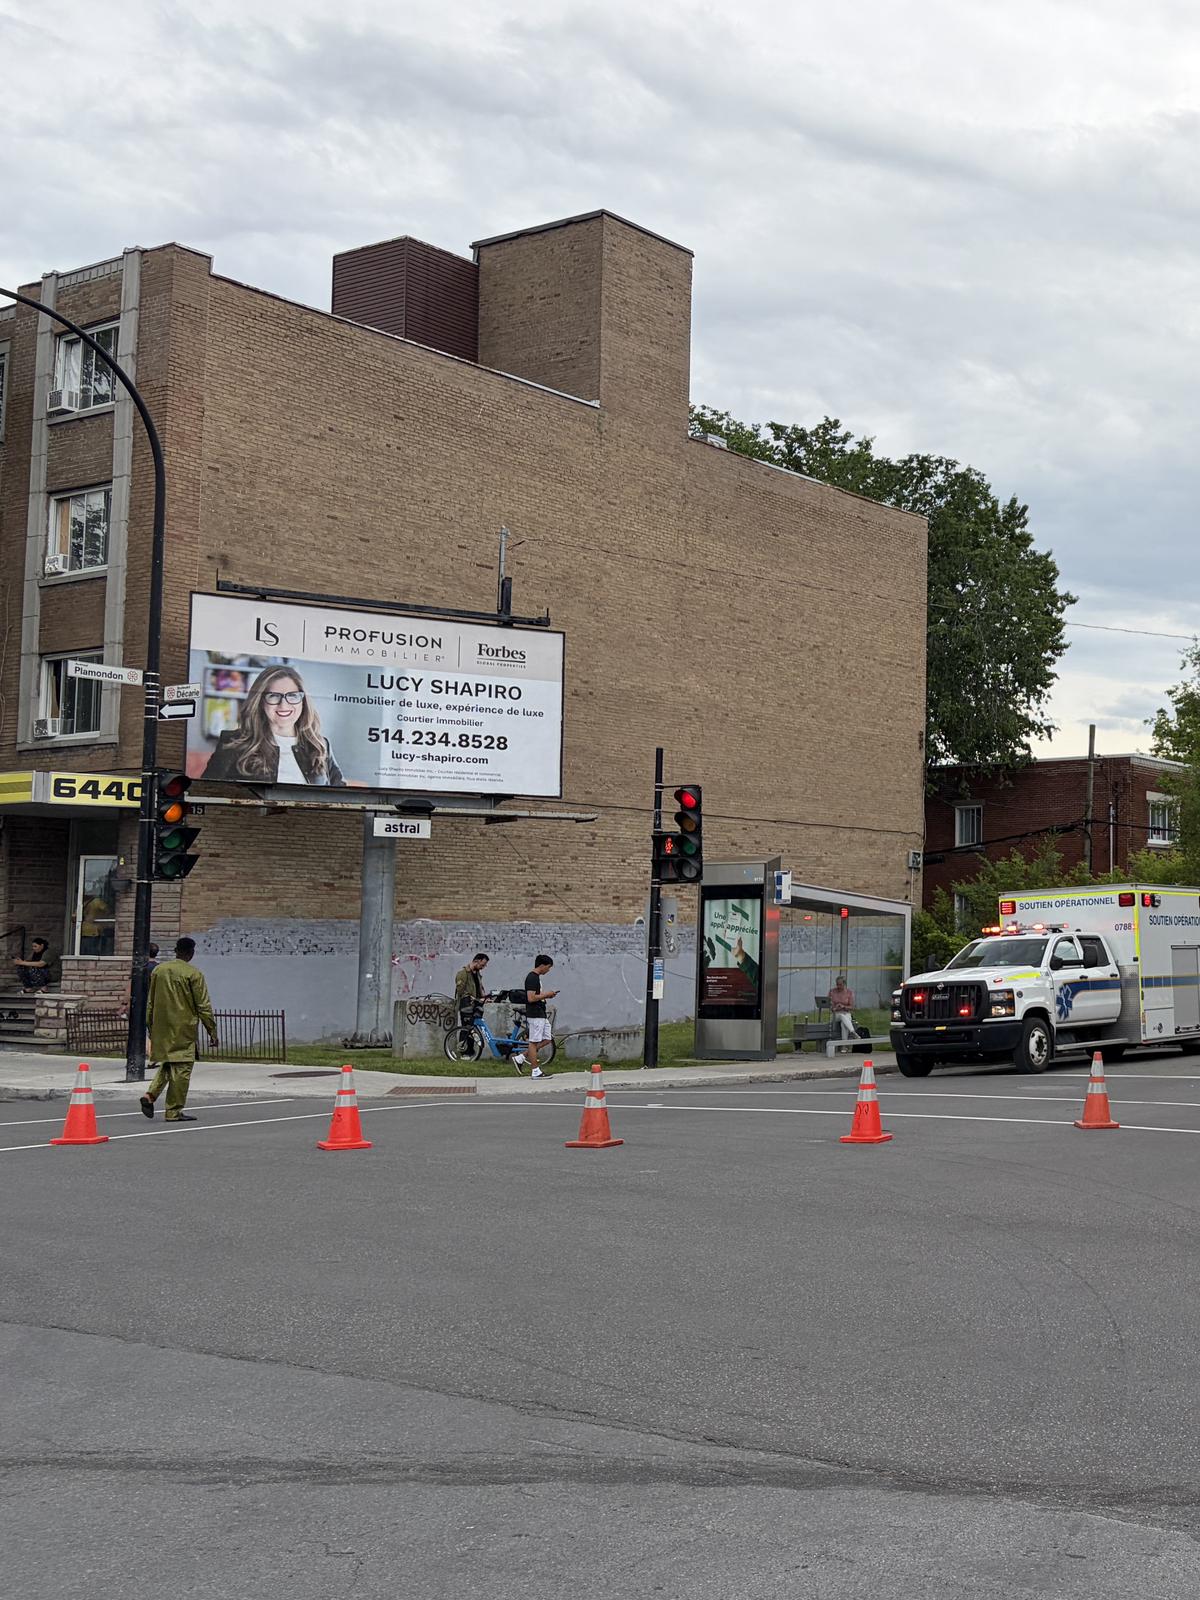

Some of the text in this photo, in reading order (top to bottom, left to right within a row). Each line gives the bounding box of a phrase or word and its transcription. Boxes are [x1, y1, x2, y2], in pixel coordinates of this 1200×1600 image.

[324, 625, 442, 649] PROFUSION
[324, 644, 442, 662] IMMOBILIER
[476, 642, 526, 660] Forbes
[74, 665, 124, 681] Plamondon
[366, 673, 522, 701] LUCY SHAPIRO
[333, 693, 544, 718] Immobilier de luxe, expérience de luxe
[396, 714, 484, 728] Courtier immobilier
[367, 727, 509, 751] 514.234.8528
[391, 750, 489, 765] lucy-shapiro.com
[53, 777, 143, 802] 6440
[384, 822, 420, 834] astral
[1019, 896, 1115, 911] SOUTIEN OPÉRATIONNEL
[714, 911, 727, 921] Une
[1149, 914, 1173, 926] SOUTIEN
